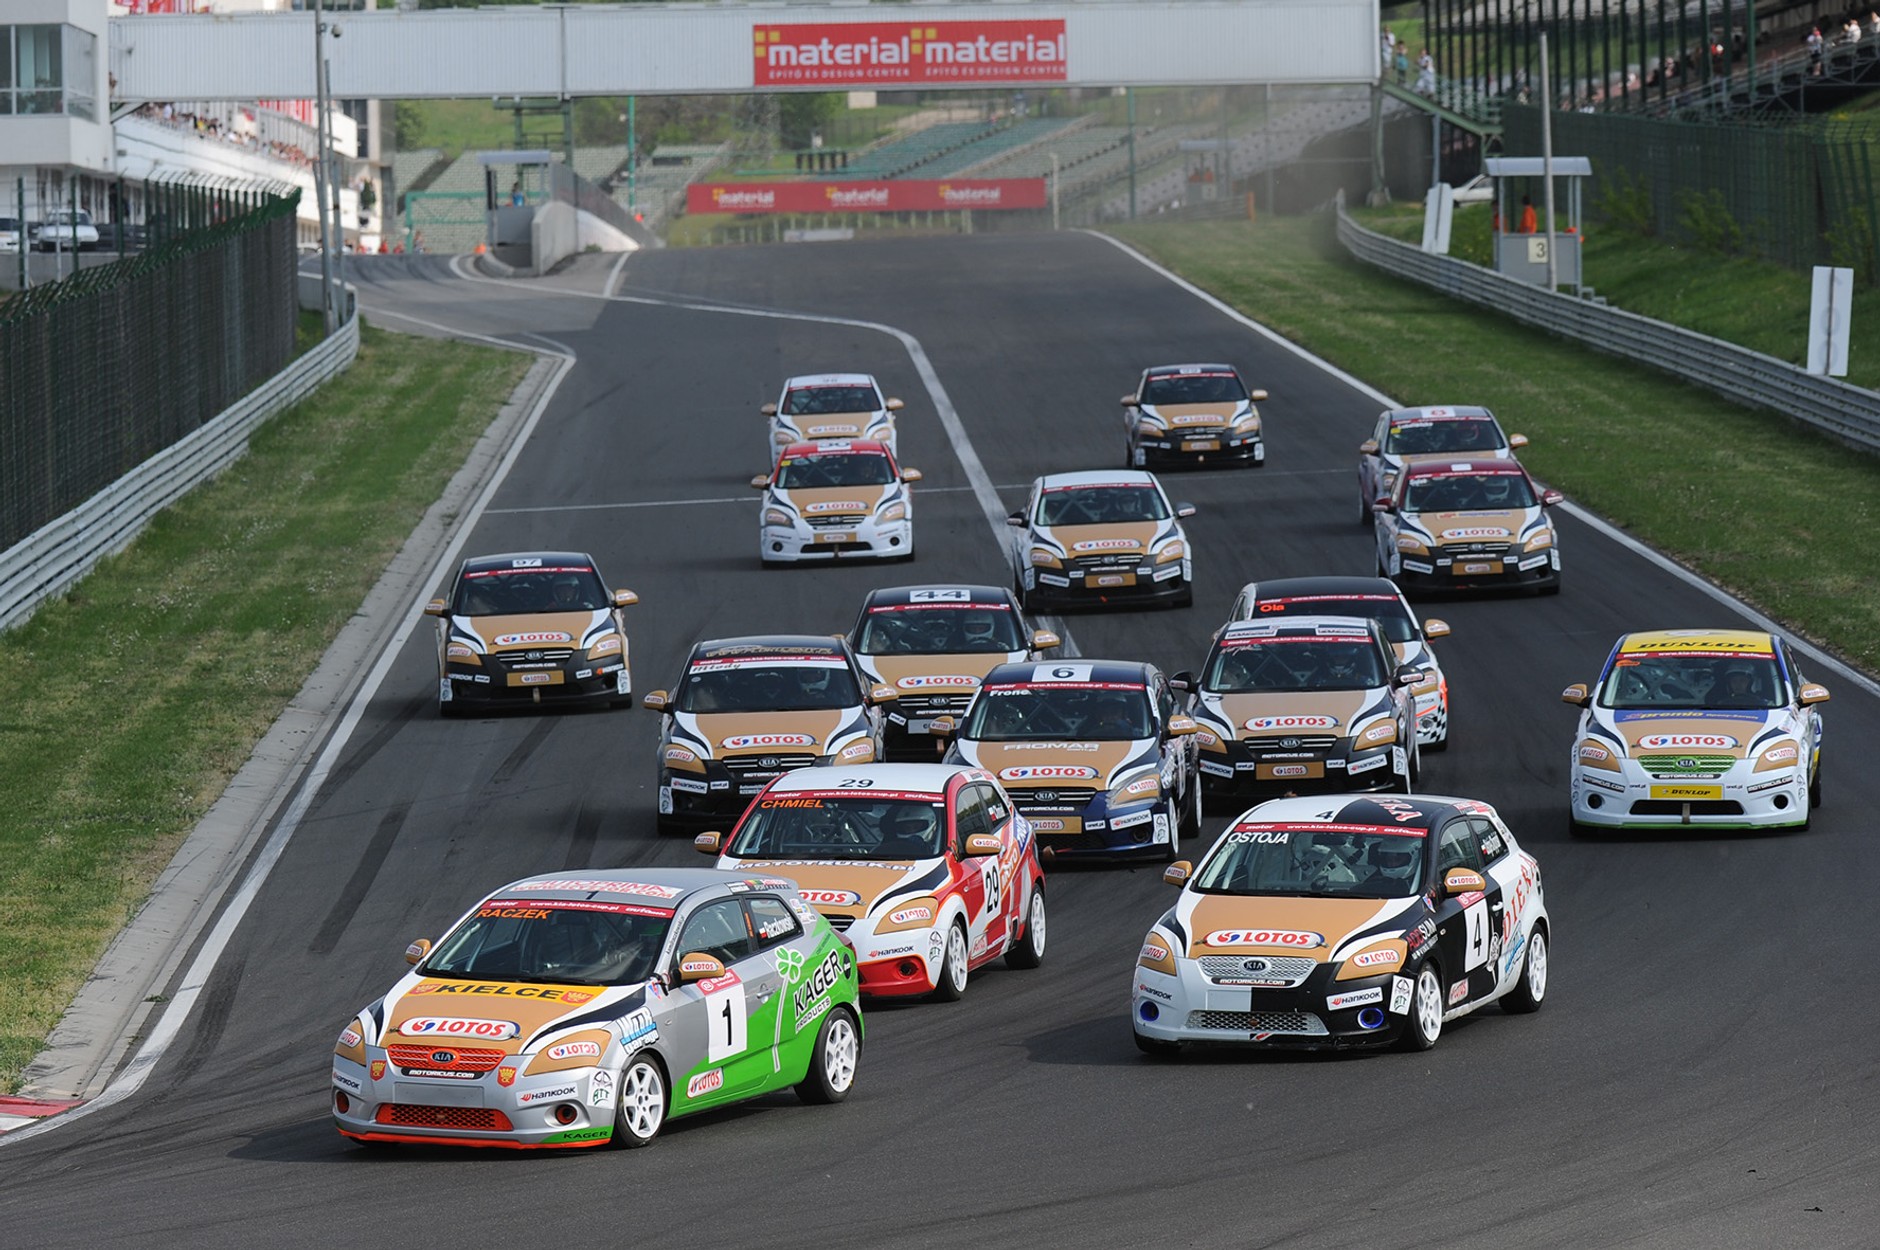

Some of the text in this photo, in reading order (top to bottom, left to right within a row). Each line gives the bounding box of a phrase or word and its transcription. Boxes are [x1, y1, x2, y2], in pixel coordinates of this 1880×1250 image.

[768, 35, 910, 67] material
[925, 32, 1065, 64] material
[821, 69, 864, 79] DESIGN
[866, 67, 910, 78] CENTER
[978, 66, 1020, 76] DESIGN
[1023, 65, 1066, 75] CENTER
[718, 190, 775, 204] material
[831, 188, 889, 203] material
[1535, 242, 1546, 258] 3
[1464, 528, 1502, 536] LOTOS
[1096, 540, 1133, 548] LOTOS
[913, 590, 968, 599] 44
[1260, 604, 1285, 613] Ola
[520, 633, 564, 642] LOTOS
[1637, 641, 1756, 650] DUNLOP
[527, 651, 542, 660] KIA
[1051, 667, 1075, 679] 6
[926, 677, 973, 685] LOTOS
[932, 697, 947, 705] KIA
[1638, 711, 1705, 720] premio
[1275, 716, 1327, 727] LOTOS
[752, 735, 804, 745] LOTOS
[1671, 735, 1726, 746] LOTOS
[672, 751, 692, 761] LOTOS
[1585, 748, 1605, 758] LOTOS
[1776, 747, 1796, 758] LOTOS
[762, 758, 777, 767] KIA
[1679, 759, 1696, 767] KIA
[1031, 767, 1087, 778] LOTOS
[1282, 766, 1304, 775] LOTOS
[837, 778, 875, 788] 29
[1137, 779, 1157, 791] LOTOS
[813, 790, 899, 798] www.kia-lotos-cup.pl
[1038, 792, 1054, 800] KIA
[1671, 788, 1711, 796] DUNLOP
[760, 799, 825, 809] CHMIEL
[1315, 810, 1334, 820] 4
[1038, 821, 1060, 830] LOTOS
[1286, 824, 1378, 833] www.kia-lotos-cup.pl
[1227, 832, 1290, 845] OSTOJA
[982, 840, 1000, 848] LOTOS
[1457, 877, 1477, 885] LOTOS
[985, 865, 999, 914] 29
[585, 890, 600, 901] 1
[798, 890, 847, 903] OTOS
[529, 902, 620, 912] www.kia-lotos-cup.pl
[474, 908, 552, 920] RACZEK
[903, 907, 928, 922] LOTOS
[1242, 932, 1311, 945] LOTOS
[1473, 912, 1482, 957] 4
[1370, 950, 1397, 963] LOTOS
[693, 963, 715, 971] LOTOS
[1245, 961, 1264, 970] KIA
[793, 950, 842, 1018] KAGER
[1219, 977, 1286, 986] MOTORICUS.COM
[435, 983, 567, 1000] KIELCE
[795, 996, 831, 1031] PRODUCTS
[721, 999, 732, 1046] 1
[438, 1020, 507, 1037] LOTOS
[566, 1042, 598, 1057] LOTOS
[434, 1052, 453, 1062] KIA
[408, 1069, 476, 1080] MOTORICUS.COM
[698, 1069, 721, 1093] LOTOS
[530, 1087, 577, 1101] HANKOOK
[563, 1130, 609, 1140] KAGER
